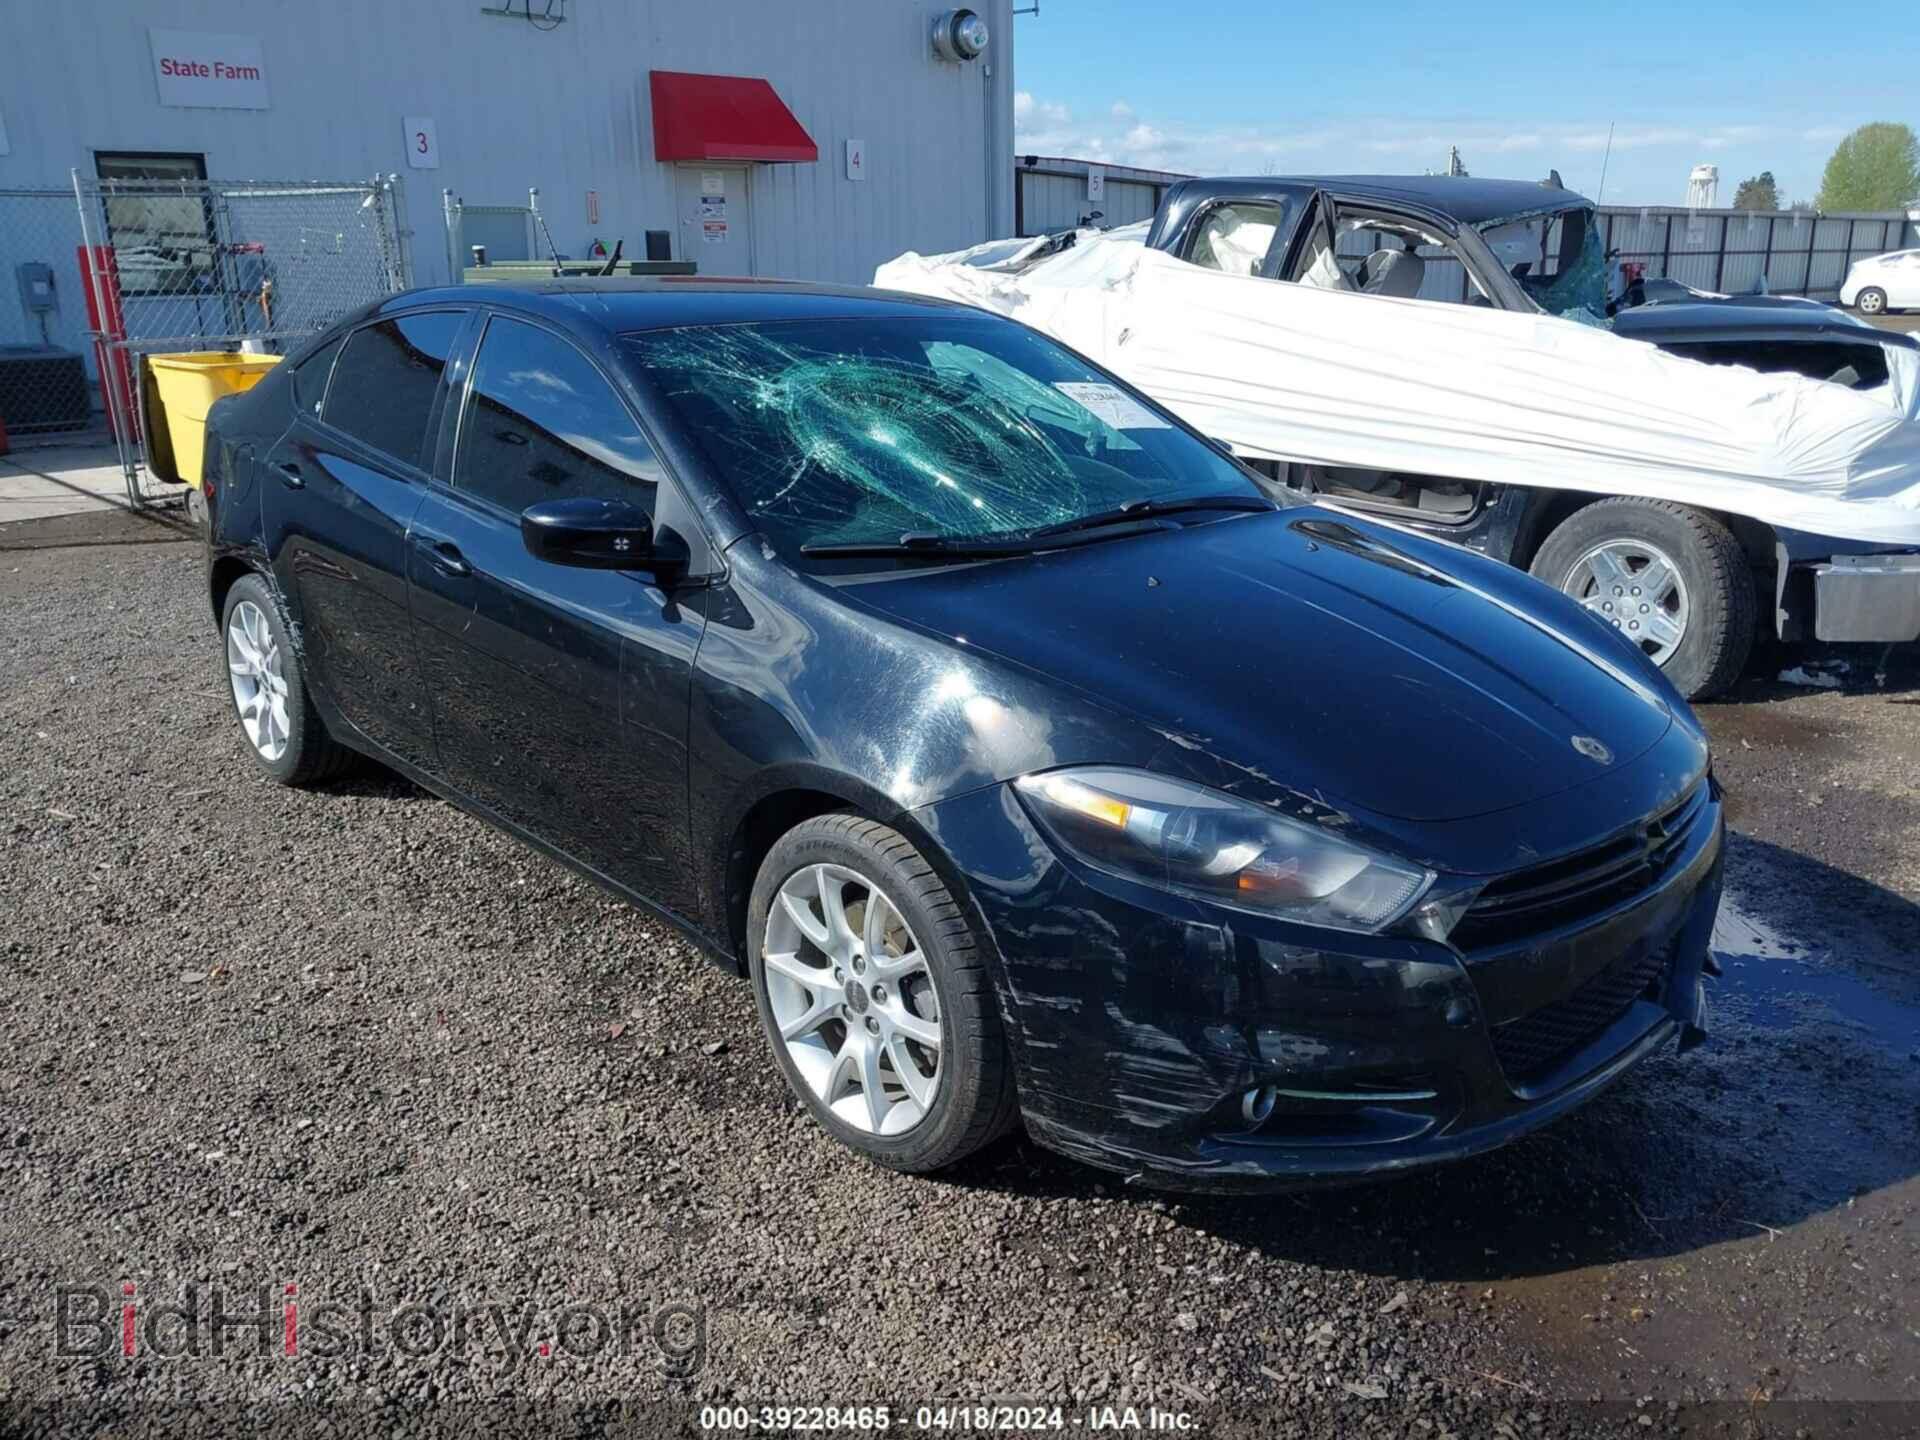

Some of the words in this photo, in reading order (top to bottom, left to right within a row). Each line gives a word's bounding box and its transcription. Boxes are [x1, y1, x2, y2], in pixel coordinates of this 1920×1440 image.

[160, 58, 209, 77] State
[214, 62, 260, 80] Farm
[416, 132, 428, 154] 3
[852, 151, 860, 168] 4
